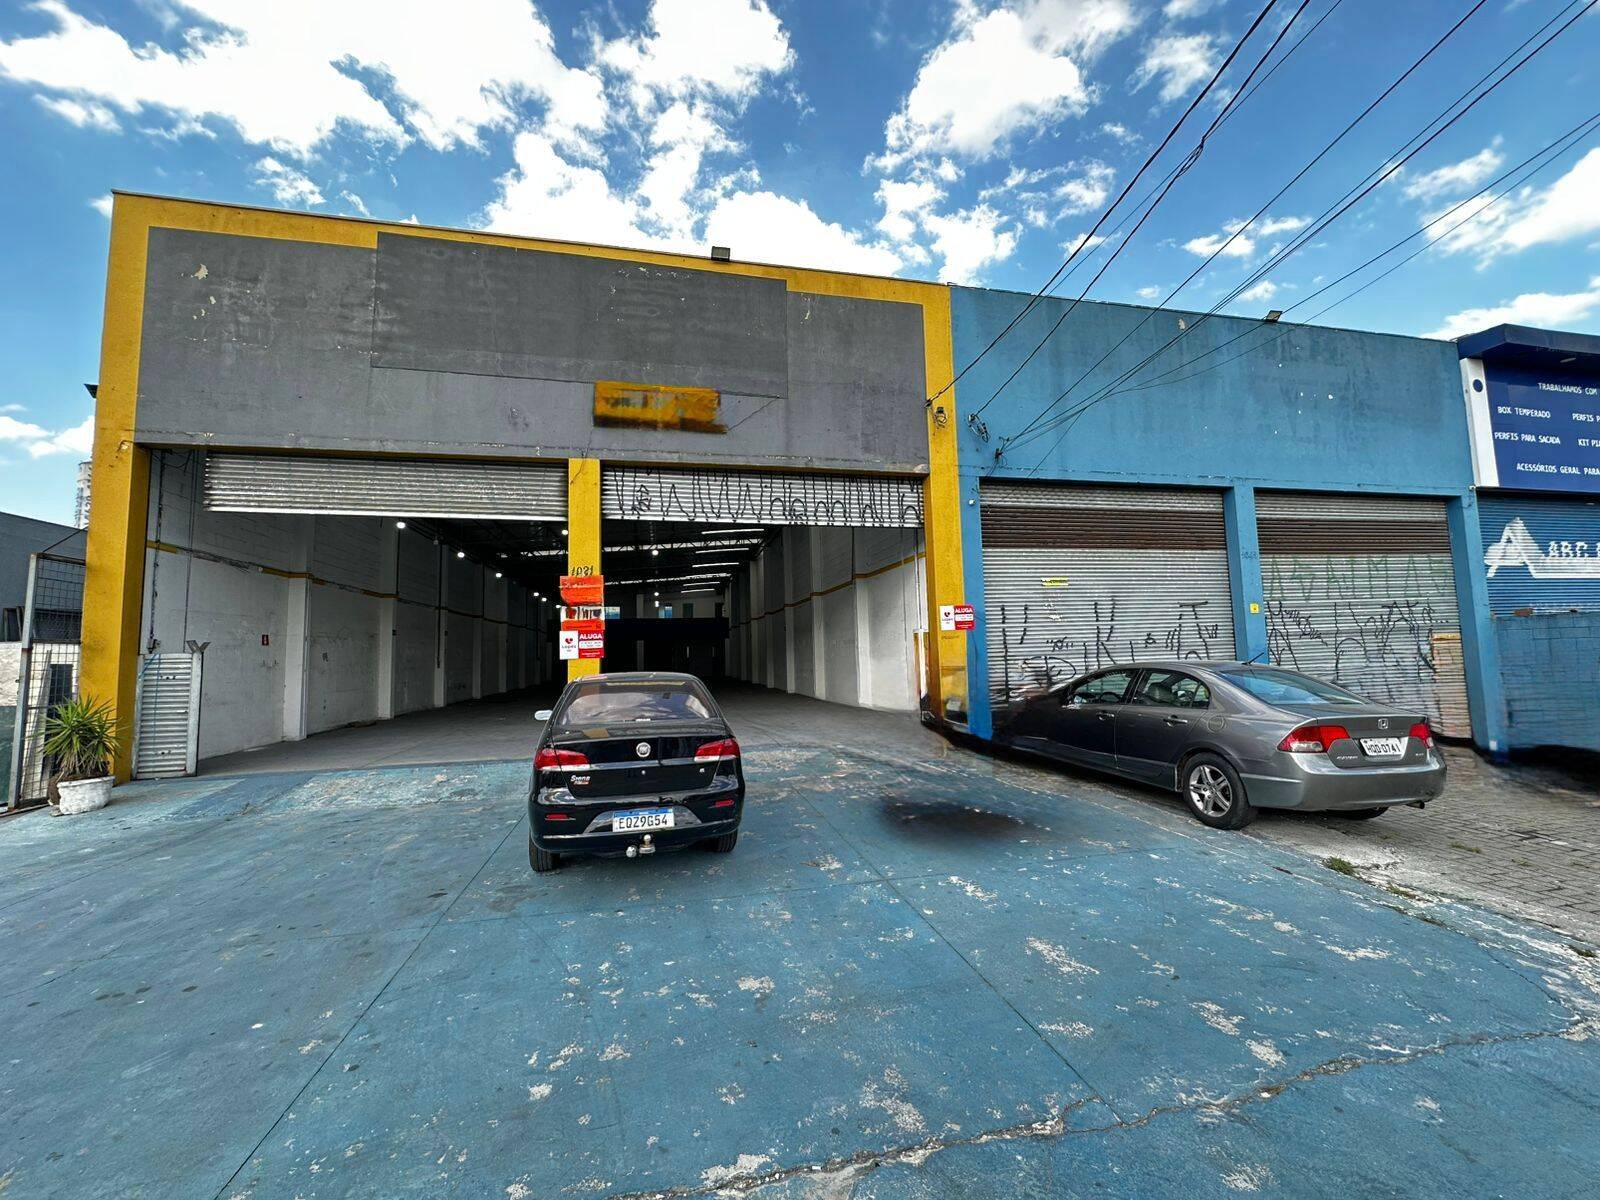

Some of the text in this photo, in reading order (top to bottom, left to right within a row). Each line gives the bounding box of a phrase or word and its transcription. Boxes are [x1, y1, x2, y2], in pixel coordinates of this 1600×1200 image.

[1538, 382, 1598, 396] TRABALHAMOS COM
[1497, 406, 1551, 419] BOX TEMPERADO
[1572, 413, 1594, 422] PERFIS
[1494, 431, 1560, 445] PERFIS PARA SACADA
[1577, 438, 1590, 447] KIT
[1516, 462, 1557, 473] ACESSÓRIOS
[1560, 465, 1581, 475] GERAL
[1548, 541, 1589, 558] ABC
